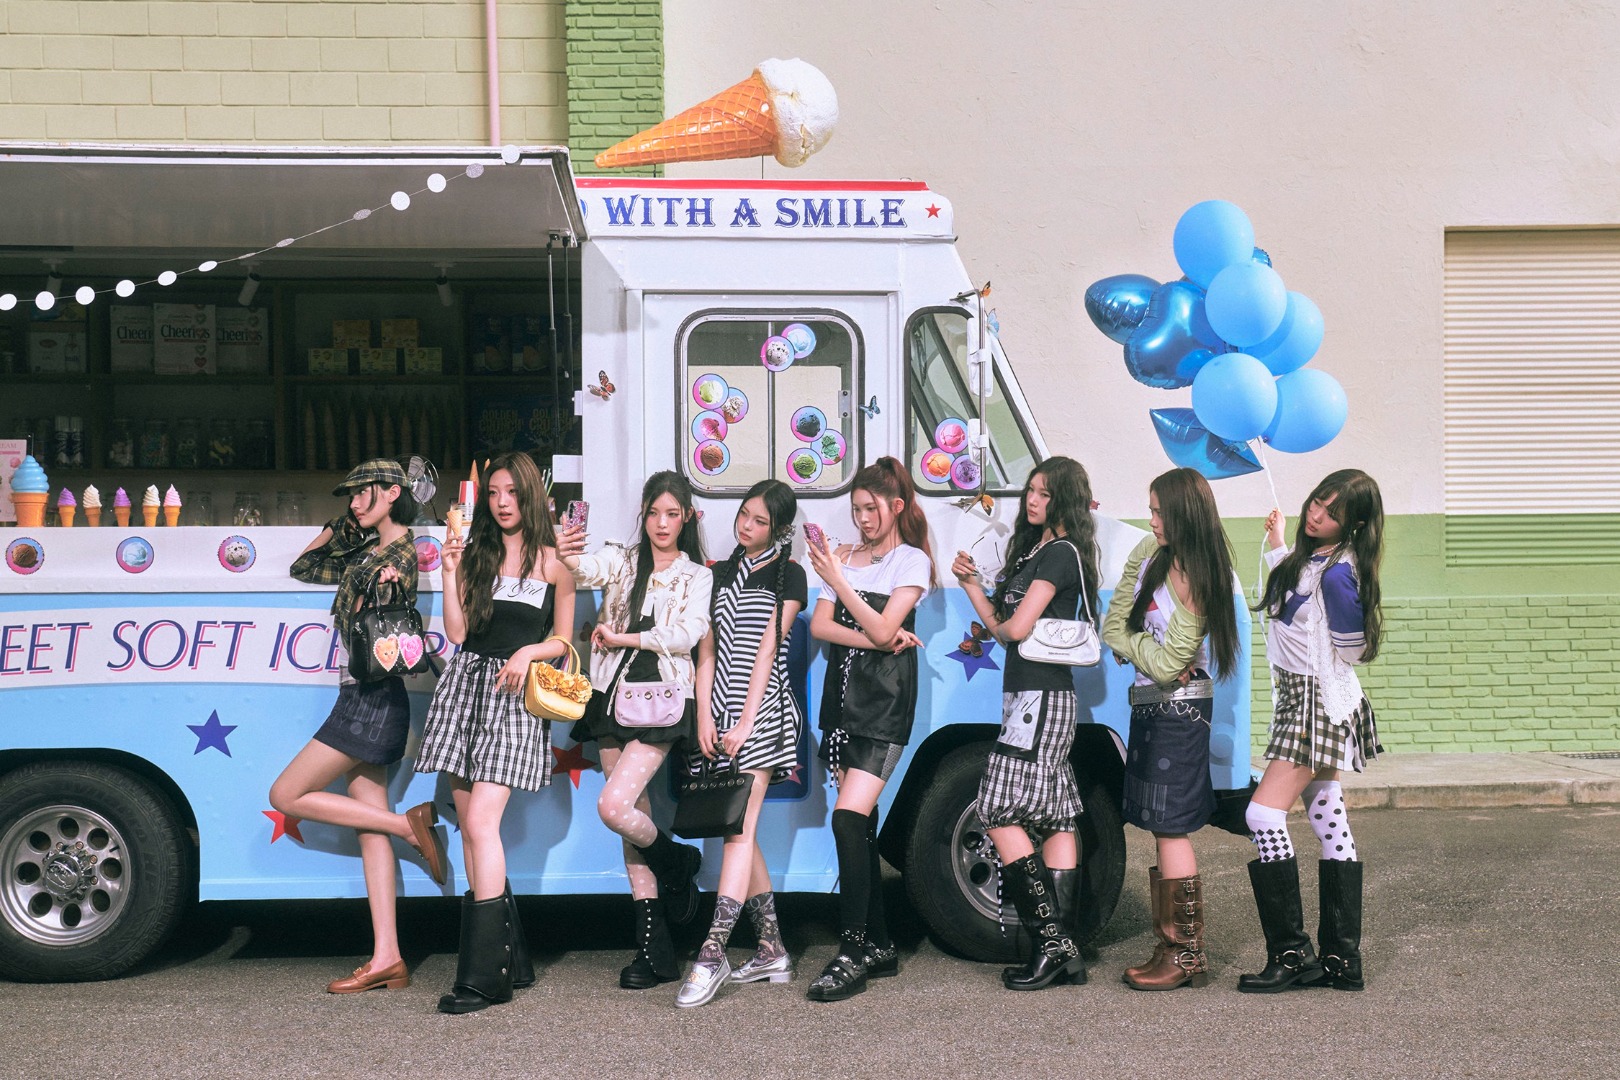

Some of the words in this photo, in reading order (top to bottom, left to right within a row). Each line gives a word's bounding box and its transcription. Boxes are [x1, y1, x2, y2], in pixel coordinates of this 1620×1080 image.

[602, 194, 715, 227] WITH
[729, 198, 761, 228] A
[774, 198, 908, 229] SMILE
[532, 408, 568, 418] GOLEN
[507, 581, 543, 598] Girl
[107, 619, 256, 672] SOFT
